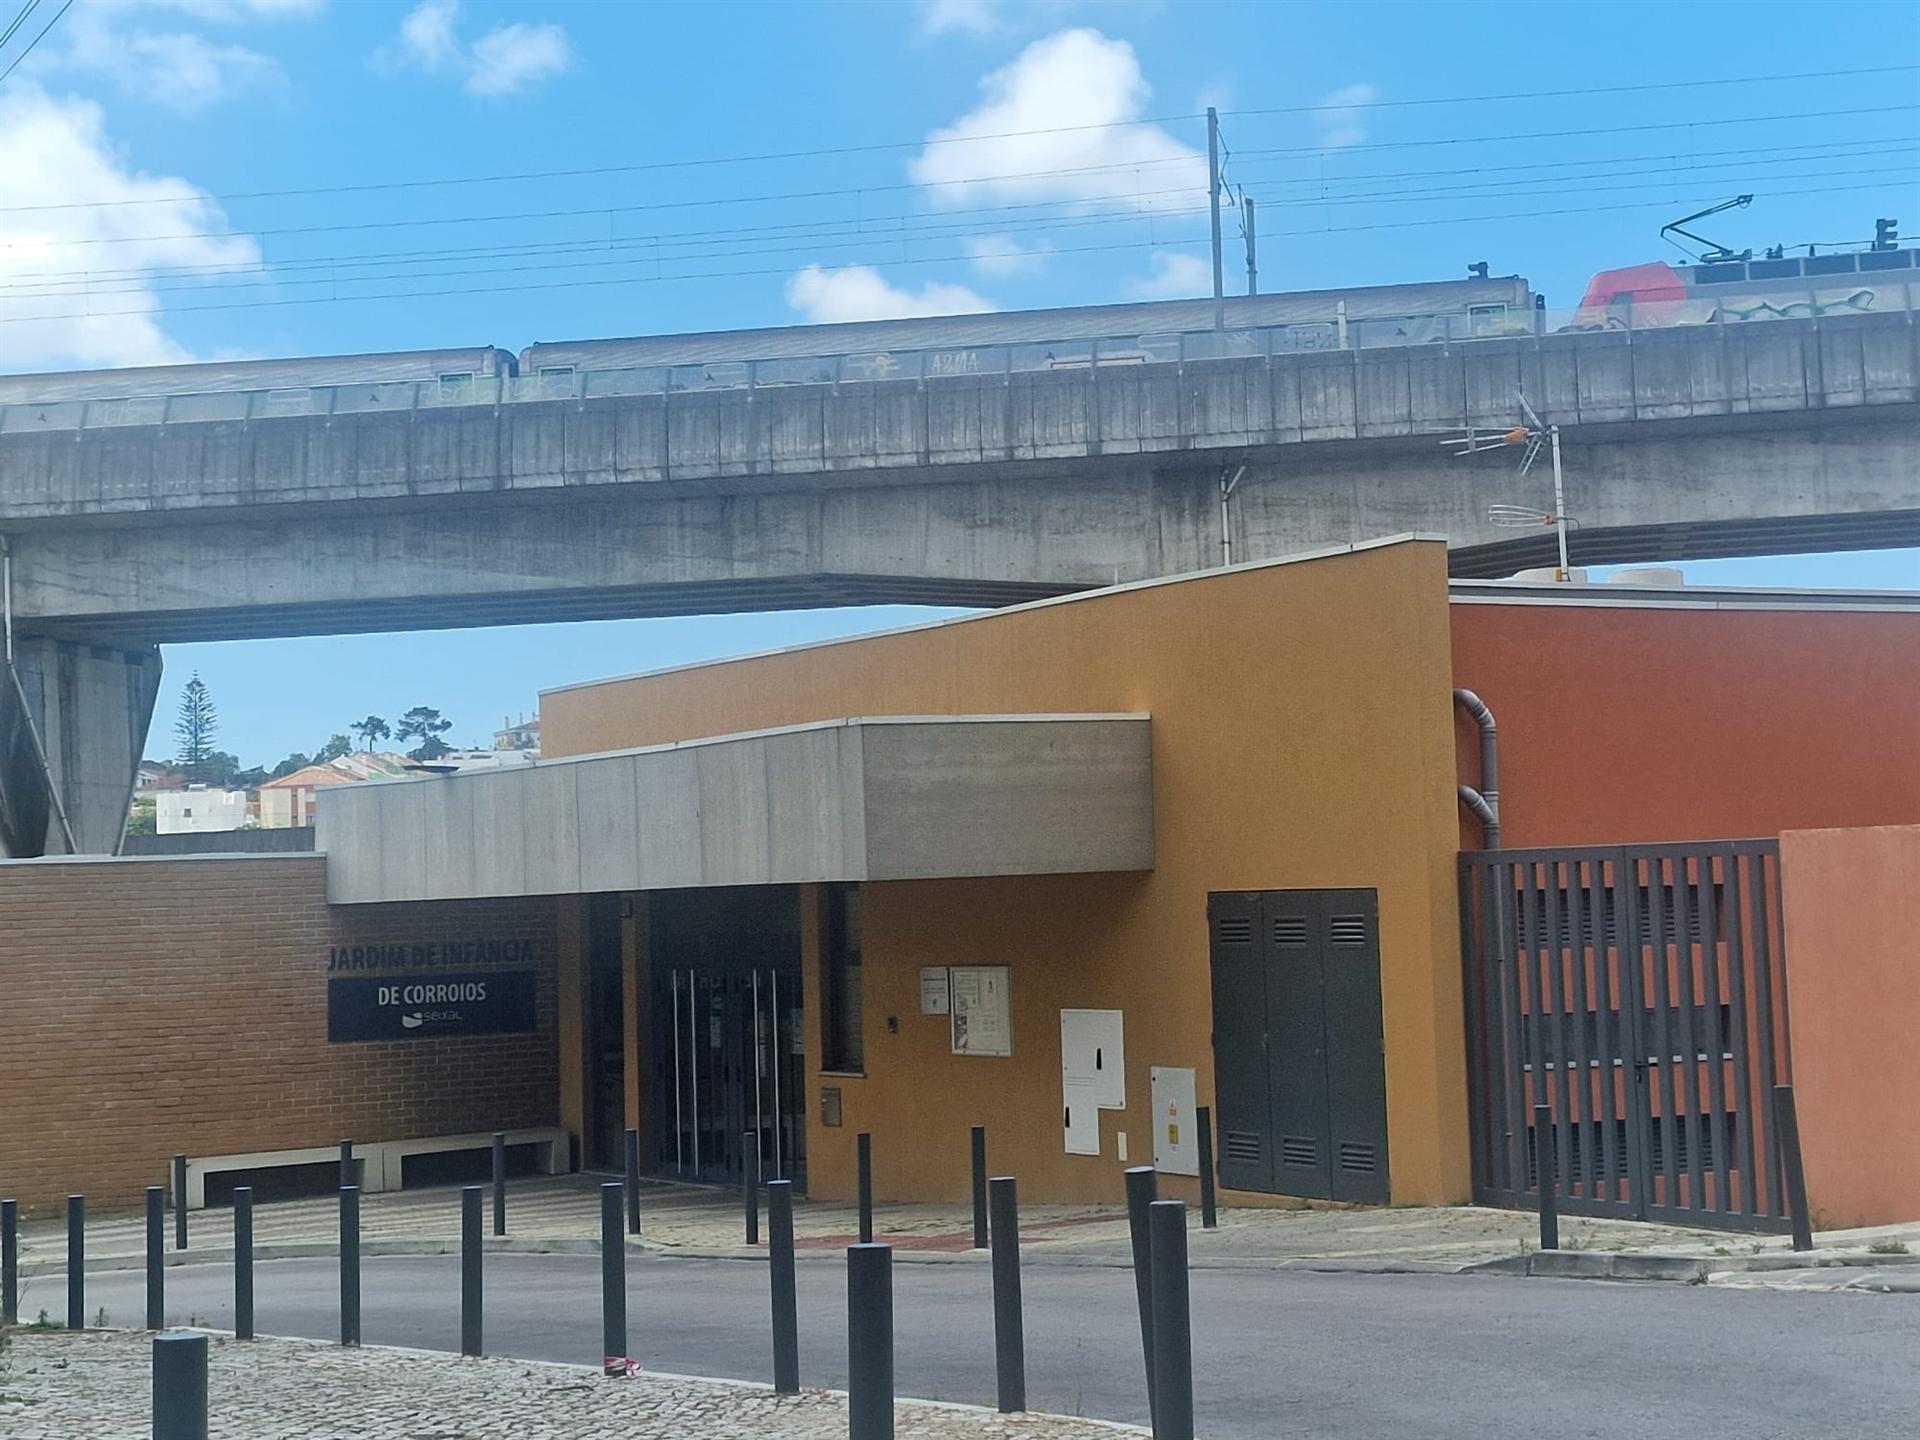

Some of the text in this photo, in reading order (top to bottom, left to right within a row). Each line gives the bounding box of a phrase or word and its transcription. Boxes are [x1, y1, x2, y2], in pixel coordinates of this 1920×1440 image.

[411, 943, 438, 967] DE
[378, 982, 487, 1006] DE CORROIOS
